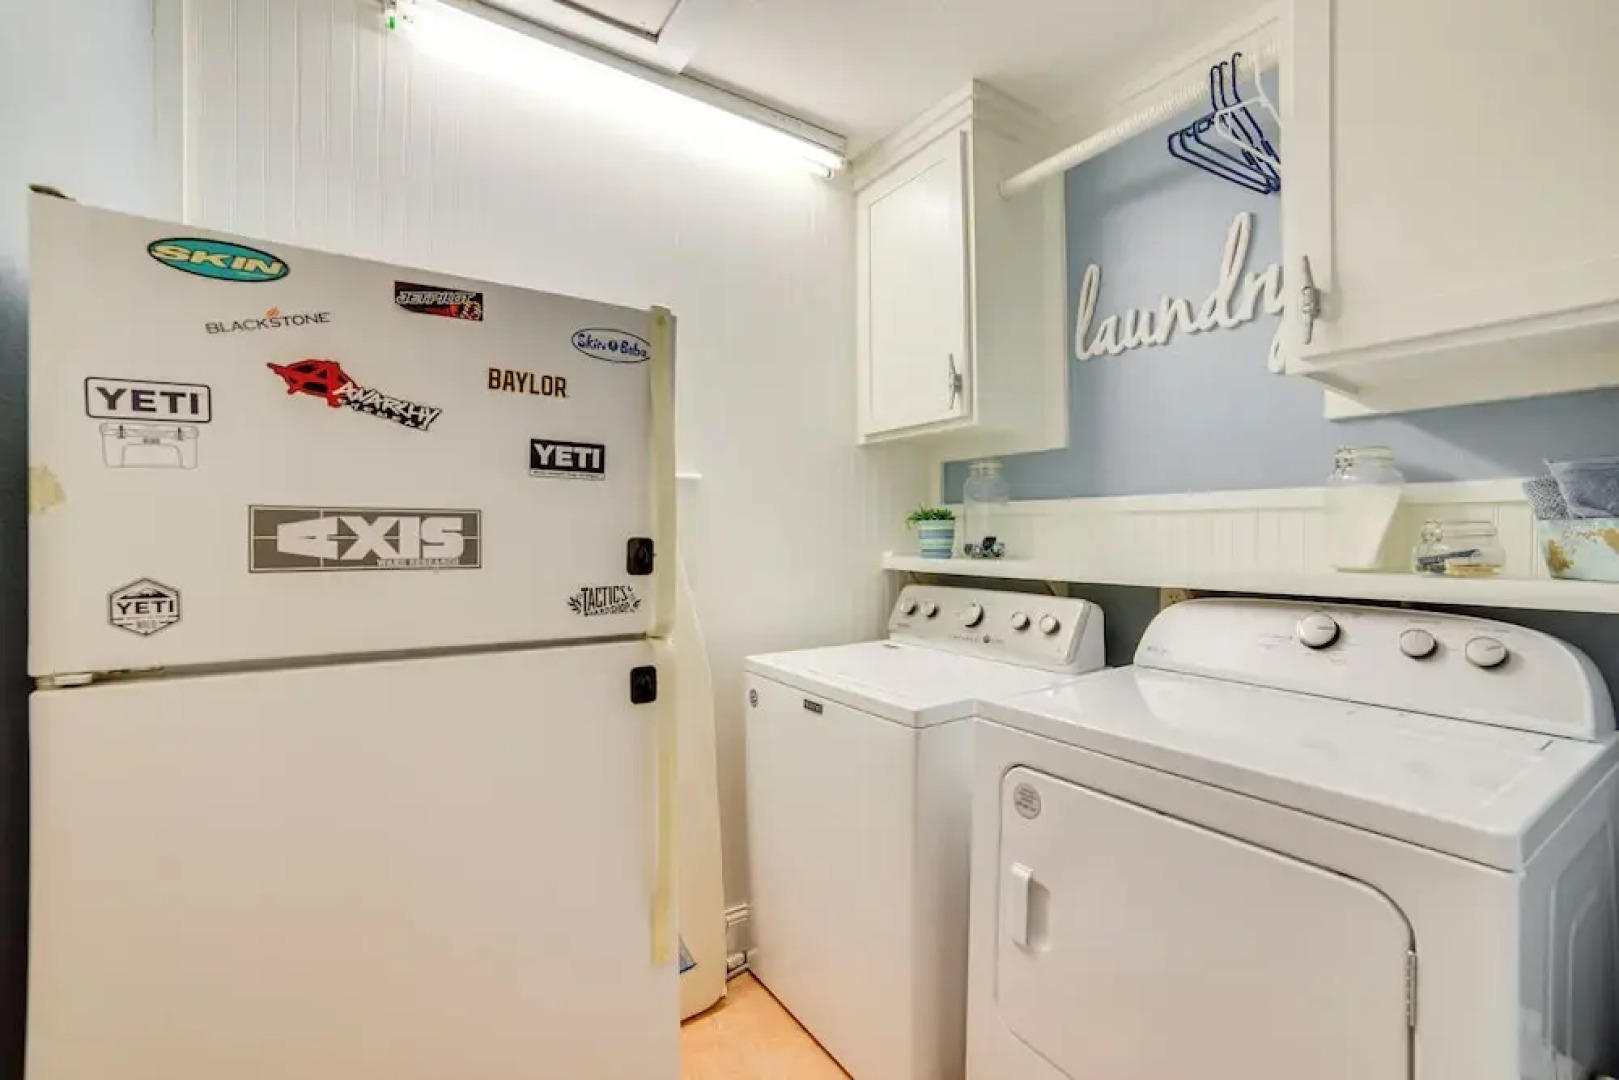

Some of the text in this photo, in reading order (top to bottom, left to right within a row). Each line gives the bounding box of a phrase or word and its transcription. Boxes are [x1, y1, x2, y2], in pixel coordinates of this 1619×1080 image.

[154, 245, 283, 275] SKIN
[205, 311, 331, 334] BLACKSTONE
[488, 367, 567, 398] BAYLOR
[95, 386, 199, 415] YETI
[533, 443, 600, 469] YETI
[276, 515, 464, 561] AXIS
[116, 600, 174, 615] YETI
[580, 585, 629, 613] TACTICS
